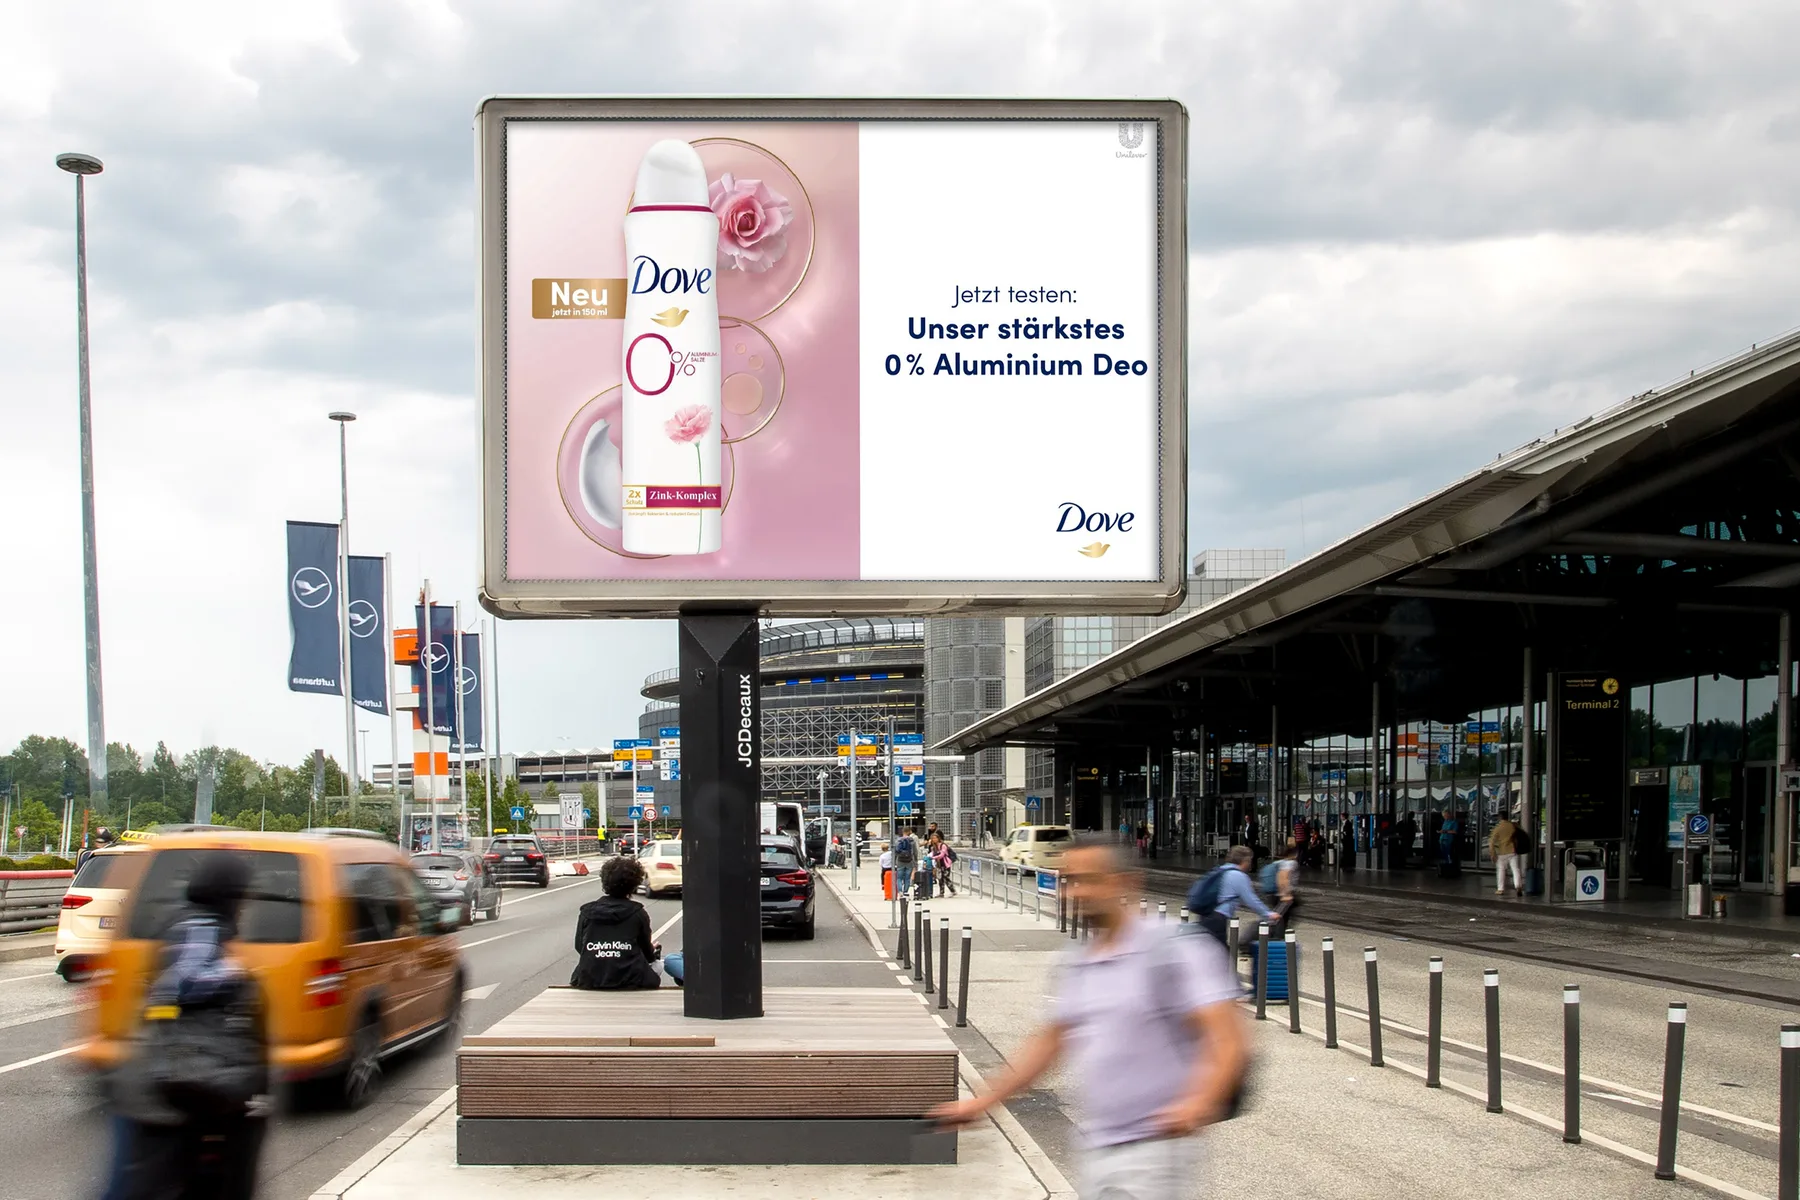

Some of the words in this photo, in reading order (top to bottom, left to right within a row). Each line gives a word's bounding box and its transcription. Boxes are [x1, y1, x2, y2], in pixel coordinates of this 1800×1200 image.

[1115, 150, 1148, 158] Unilever
[632, 255, 713, 295] Dove
[551, 281, 608, 306] Neu
[951, 284, 1000, 309] Jetzt
[1007, 284, 1077, 305] testen:
[551, 308, 571, 318] jetzt
[573, 308, 581, 316] in
[582, 308, 595, 316] 150
[597, 308, 608, 316] ml
[908, 316, 989, 340] Unser
[997, 315, 1125, 340] stärkstes
[933, 352, 1082, 376] Aluminium
[1093, 352, 1148, 376] Deo
[649, 490, 718, 504] Zink-Komplex
[1056, 502, 1135, 533] Dove
[1565, 700, 1611, 710] Terminal
[1613, 700, 1619, 708] 2
[738, 674, 752, 768] JCDecaux
[586, 941, 612, 951] Calvin
[612, 940, 632, 951] Klein
[595, 949, 621, 958] Jeans
